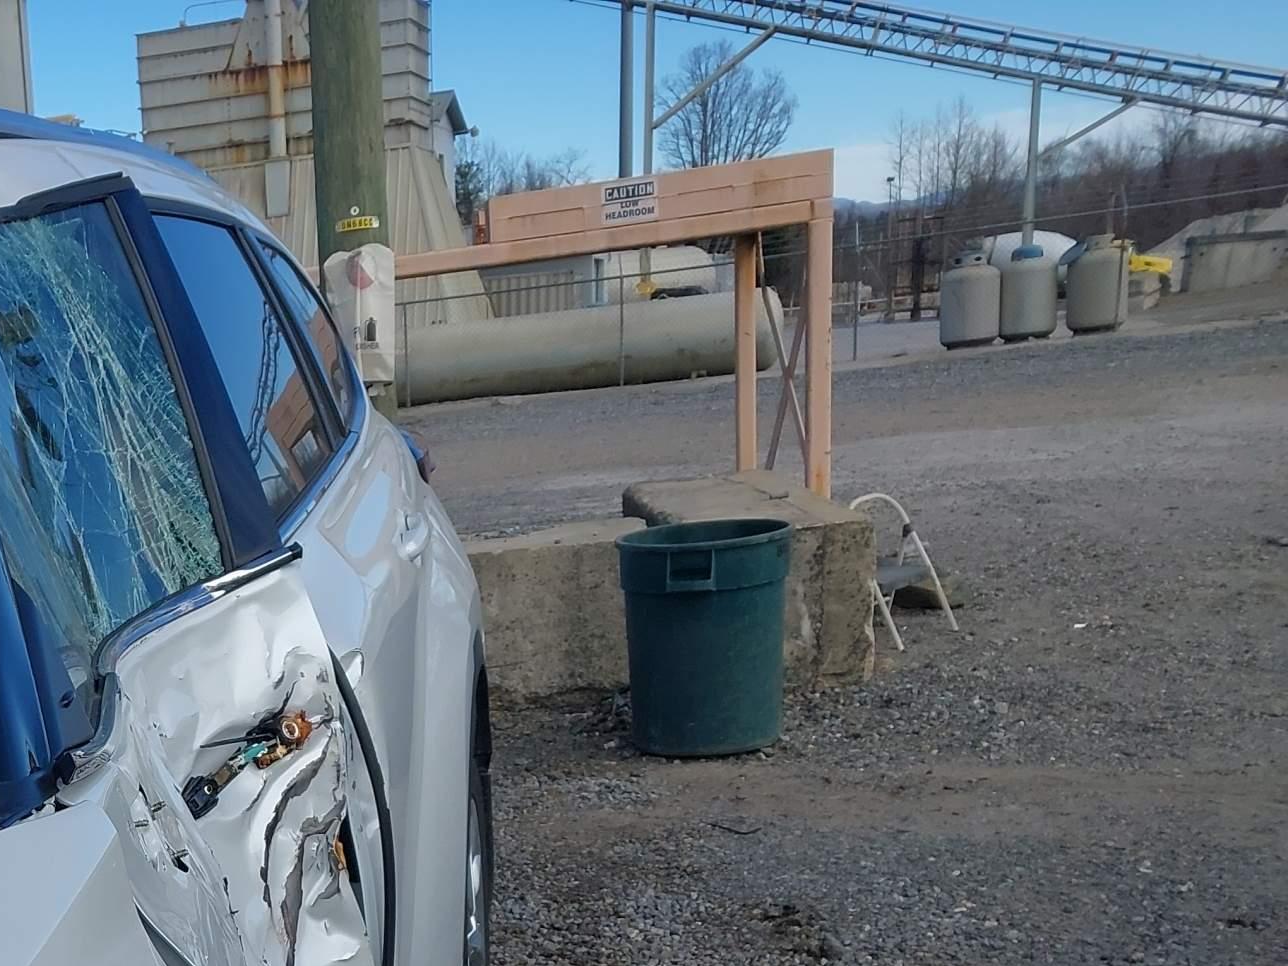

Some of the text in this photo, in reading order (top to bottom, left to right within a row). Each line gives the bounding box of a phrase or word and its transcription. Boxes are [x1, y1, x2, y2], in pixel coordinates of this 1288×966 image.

[605, 182, 654, 200] CAUTION
[620, 199, 639, 209] LOW
[605, 205, 655, 220] HEADROOM
